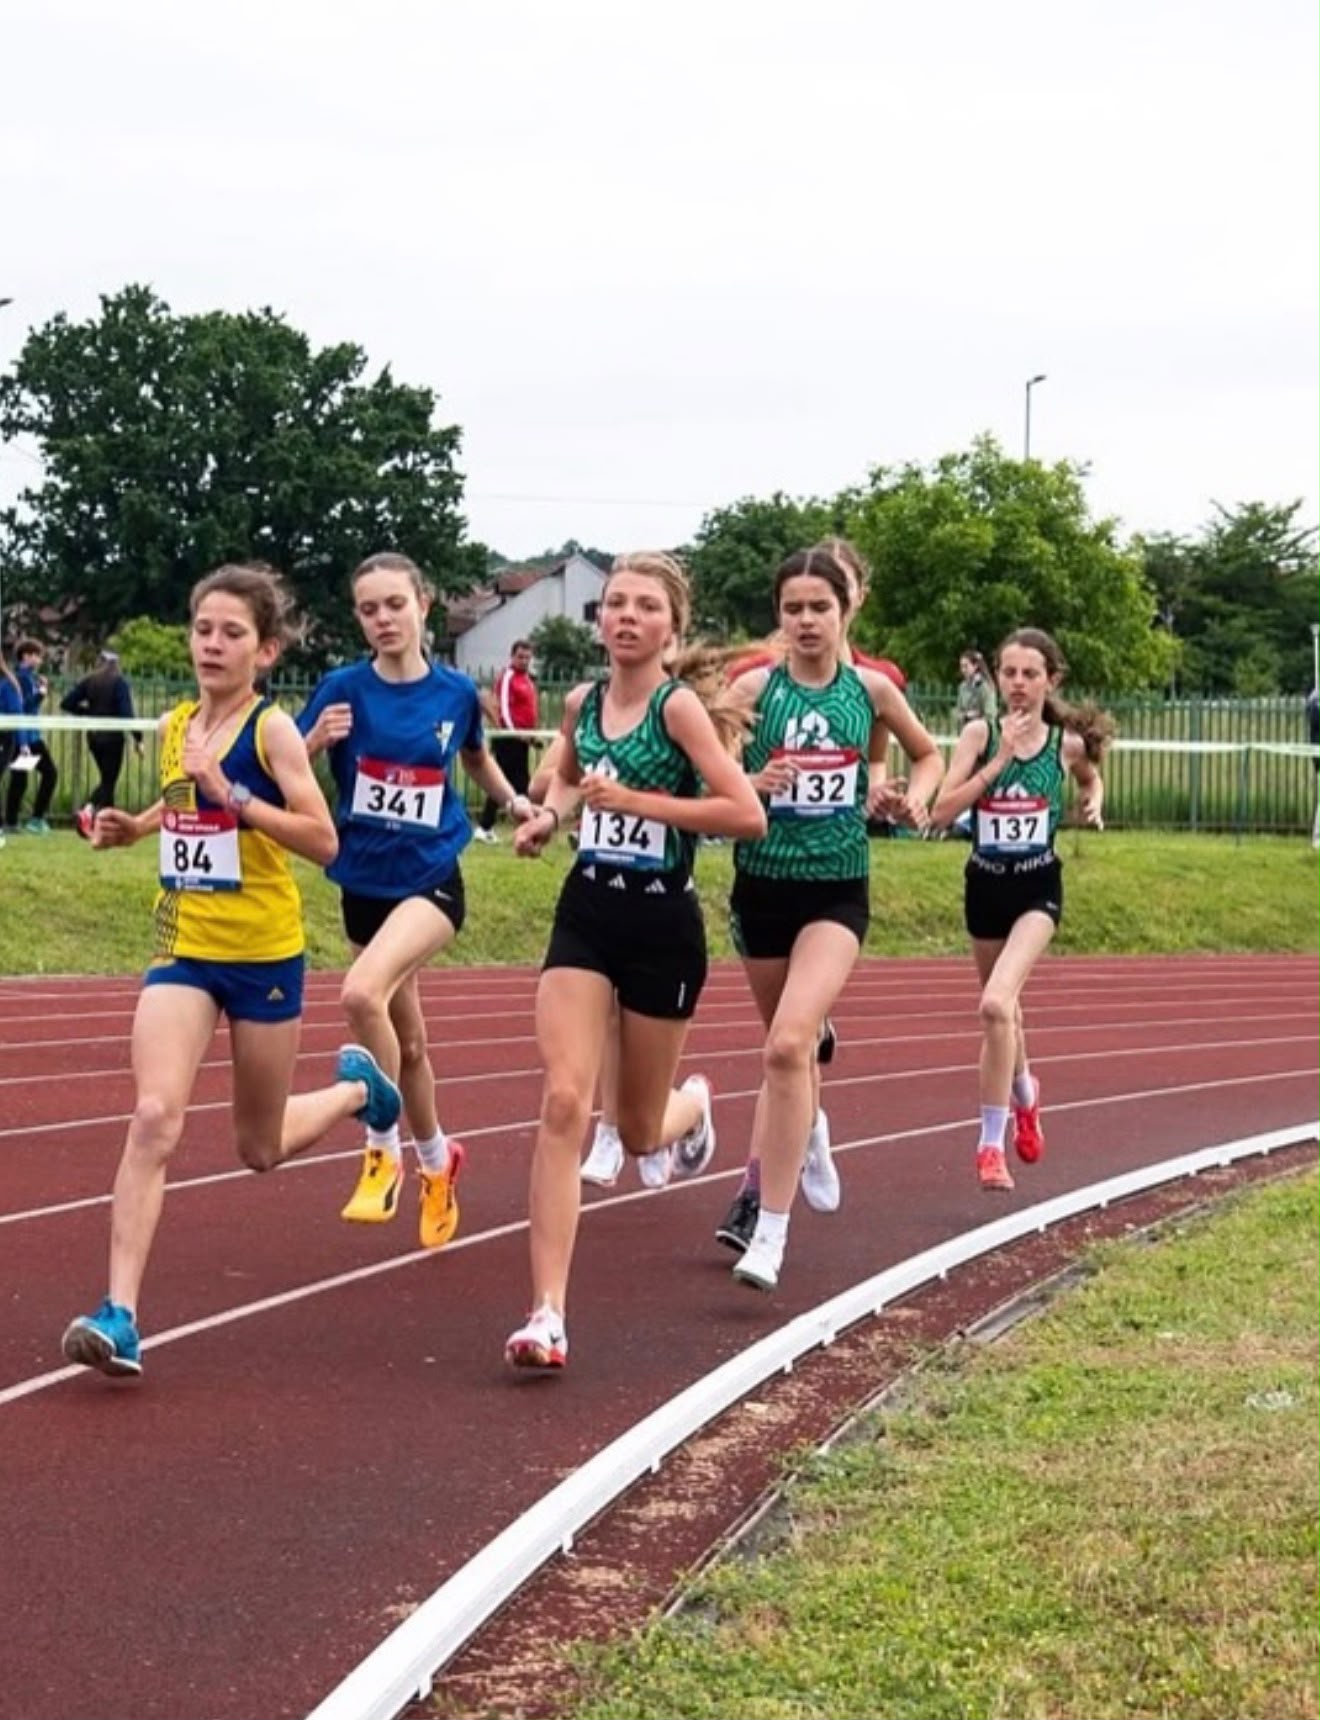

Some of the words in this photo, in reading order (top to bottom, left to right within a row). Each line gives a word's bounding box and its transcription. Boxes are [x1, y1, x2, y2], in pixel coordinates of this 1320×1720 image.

[367, 784, 426, 820] 341
[791, 774, 845, 803] 132
[592, 812, 650, 849] 134
[990, 816, 1039, 841] 137
[173, 839, 213, 874] 84
